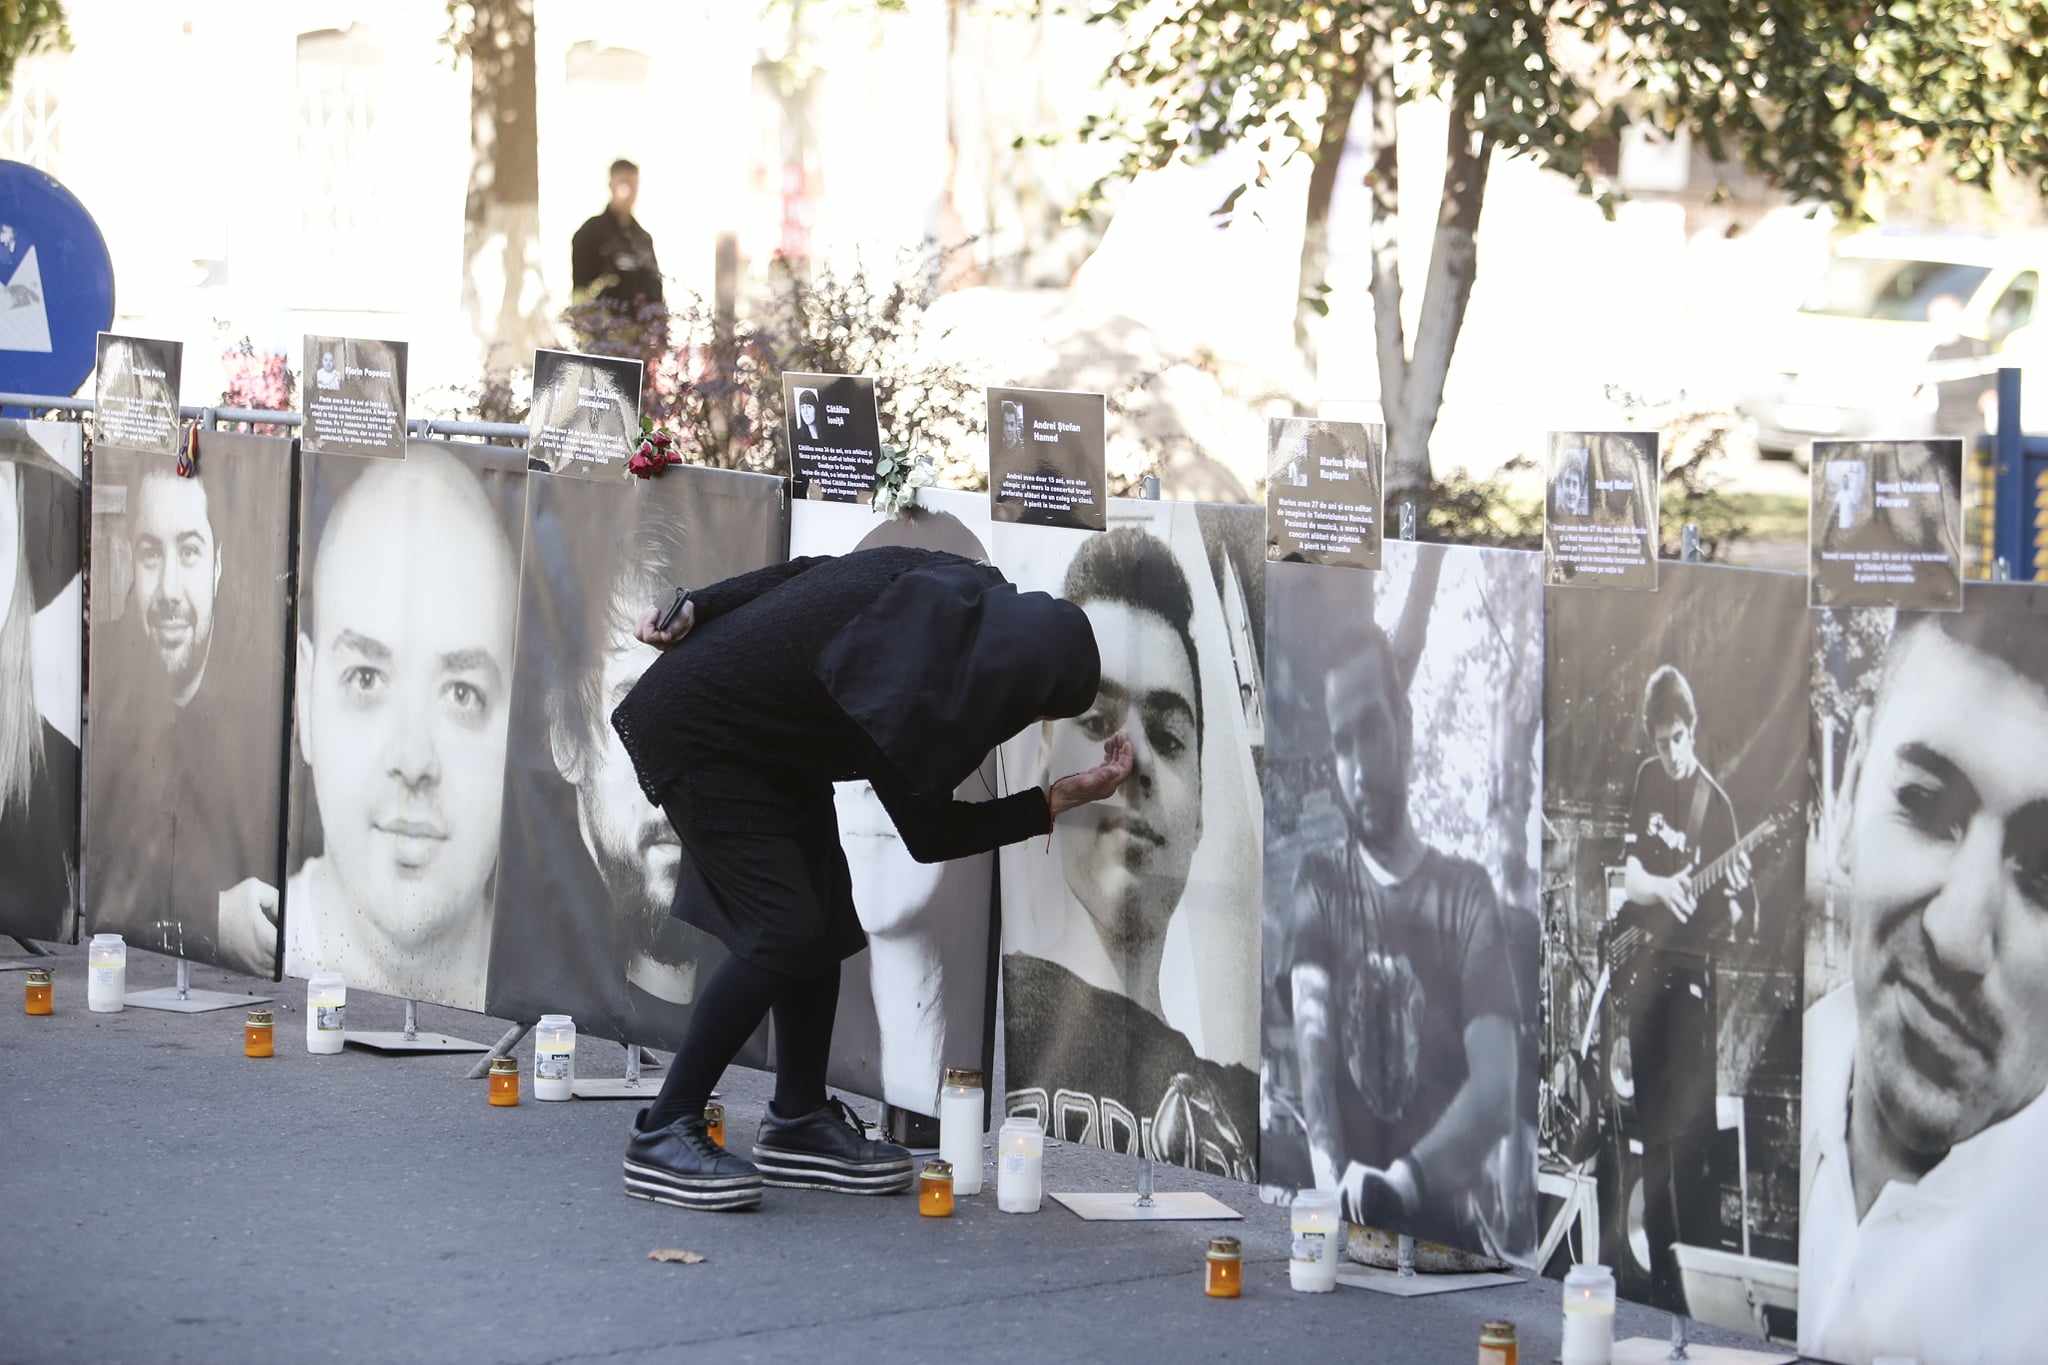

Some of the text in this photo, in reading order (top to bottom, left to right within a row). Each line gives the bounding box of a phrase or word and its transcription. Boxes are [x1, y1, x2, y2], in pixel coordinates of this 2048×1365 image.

[345, 367, 391, 379] Florin Popescu
[577, 399, 610, 409] Alexandru
[826, 405, 850, 414] Cătălina
[827, 416, 844, 427] Ioniță
[1034, 420, 1081, 434] Andrei Ștefan
[1034, 432, 1058, 442] Hamed
[1320, 457, 1343, 466] Marius
